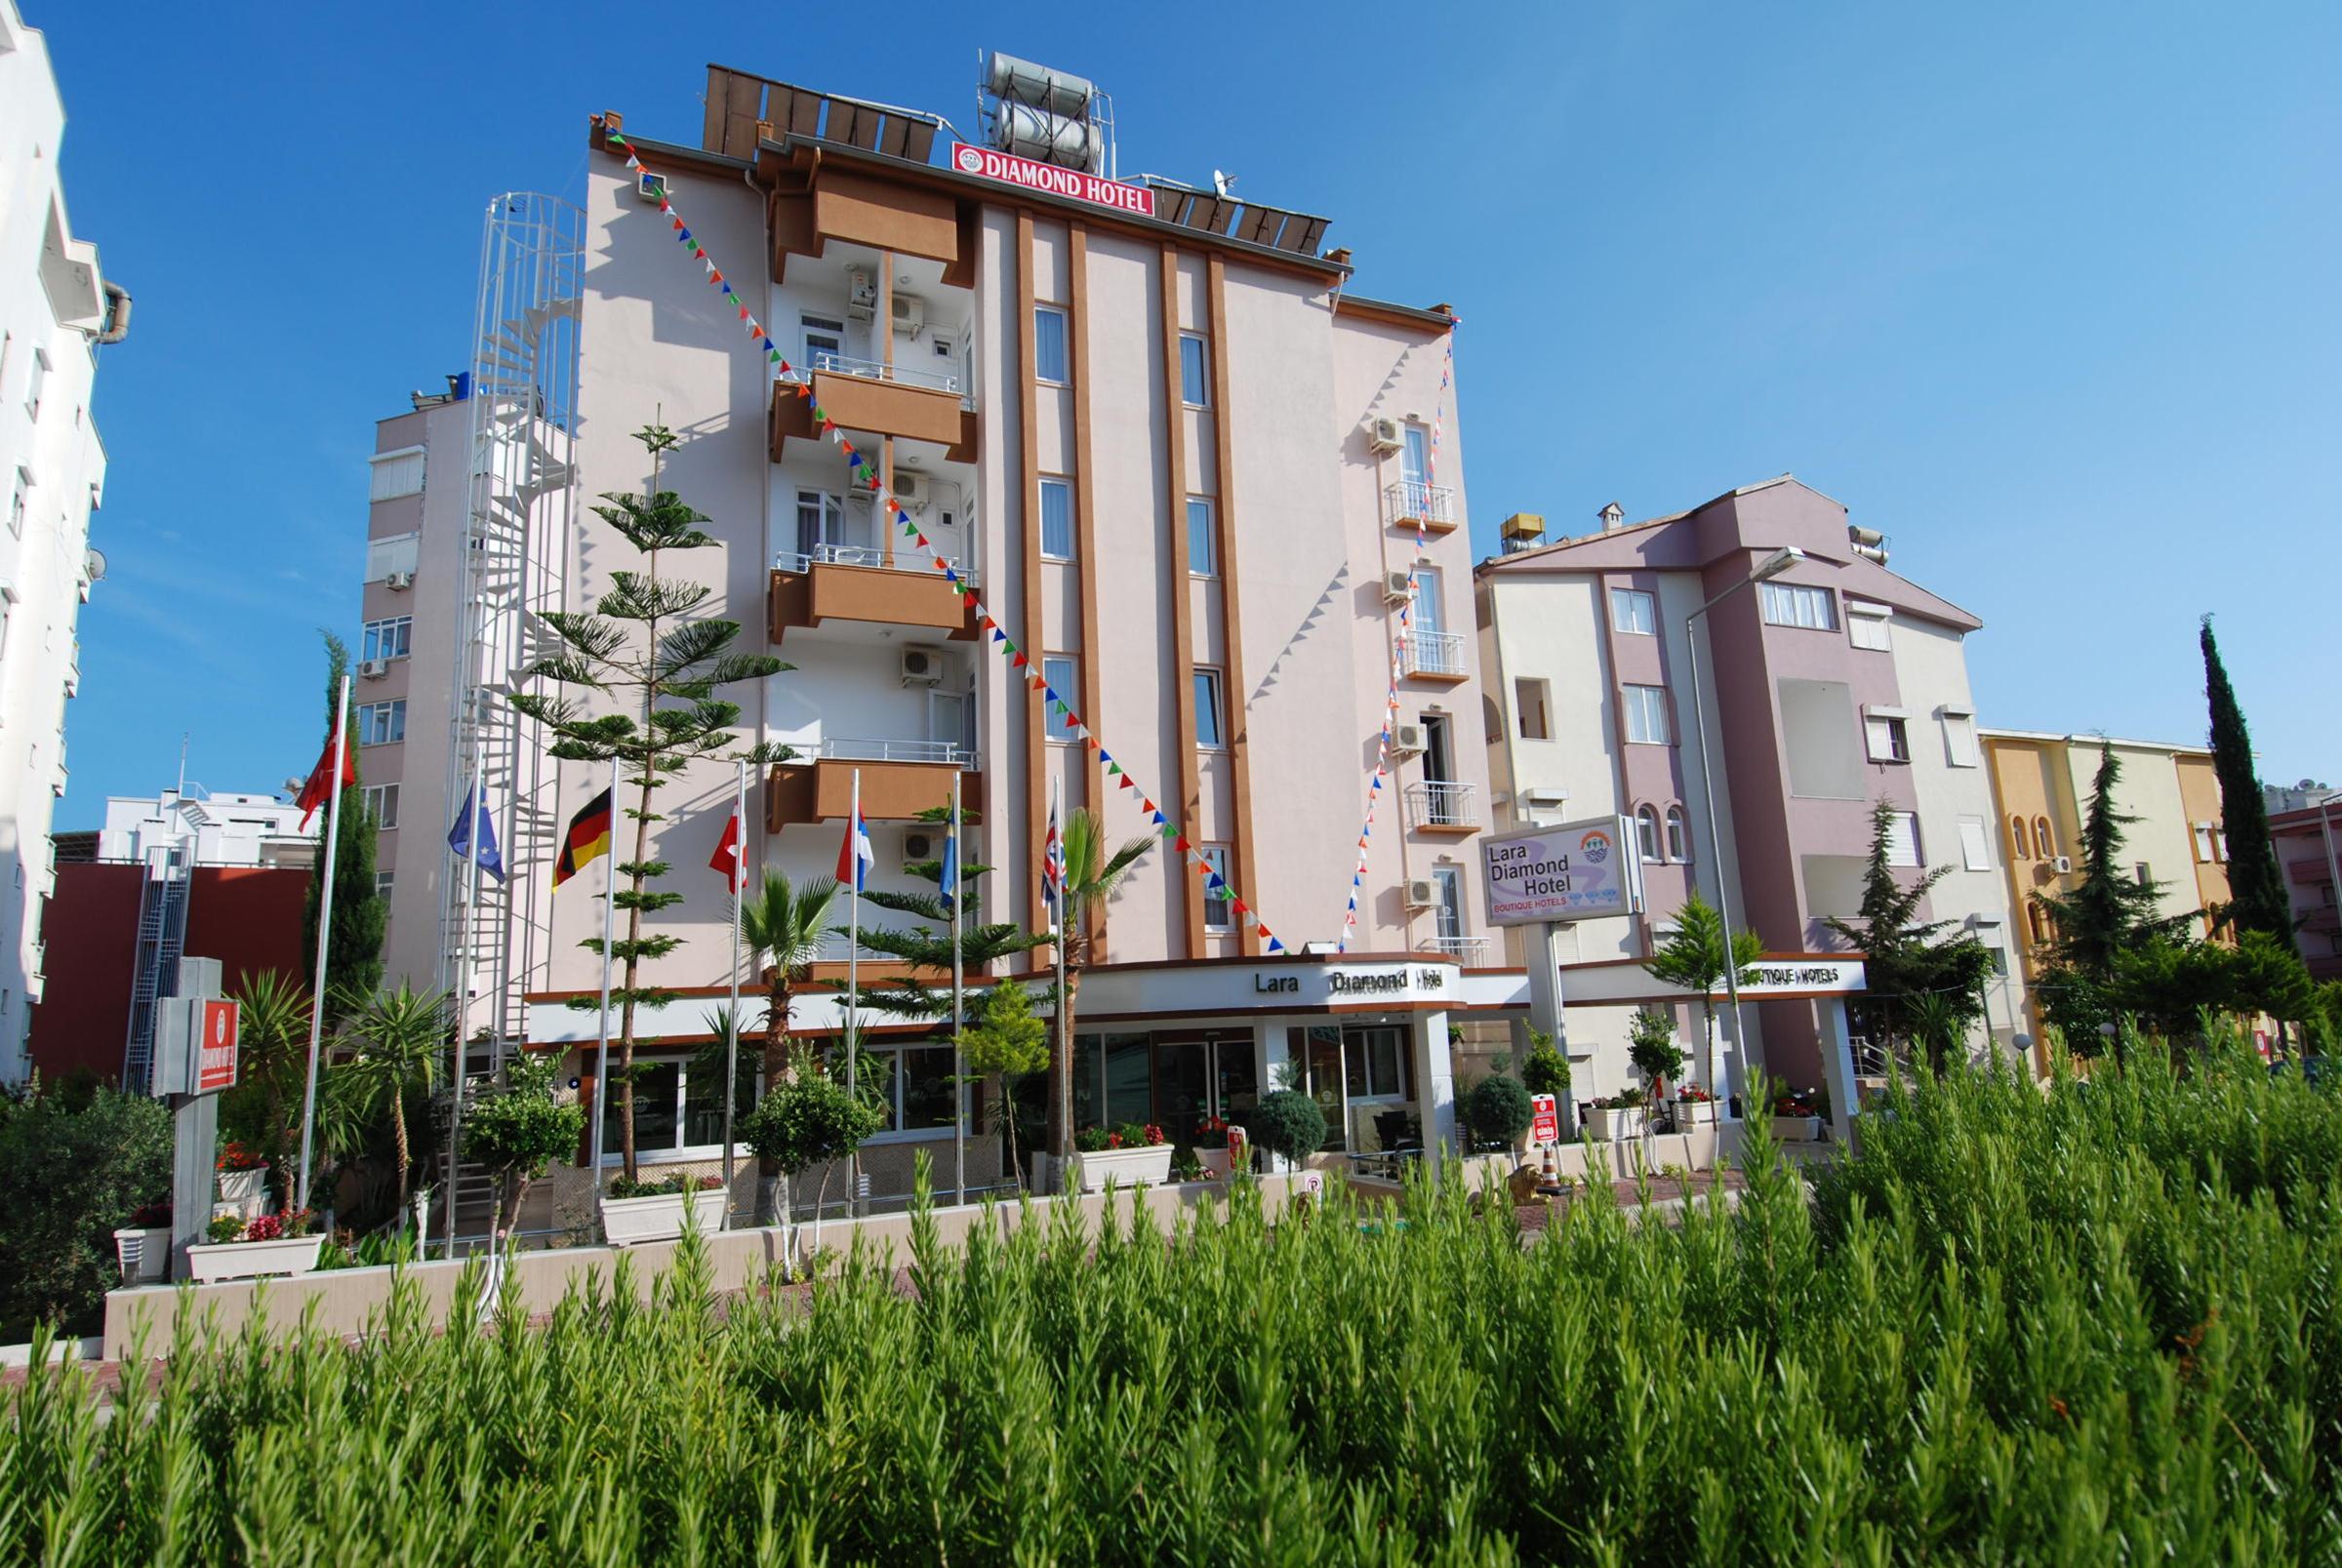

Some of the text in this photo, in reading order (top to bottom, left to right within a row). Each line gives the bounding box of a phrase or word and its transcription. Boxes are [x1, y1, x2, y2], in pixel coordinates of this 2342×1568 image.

[986, 153, 1148, 213] DIAMOND HOTEL
[1489, 844, 1527, 863] Lara
[1491, 855, 1569, 881] Diamond
[1524, 874, 1571, 896] Hotel
[1493, 897, 1567, 913] BOUTIQUE HOTELS
[1255, 973, 1299, 993] Lara
[1332, 969, 1408, 991] Diamond
[1800, 968, 1838, 984] HOTELS
